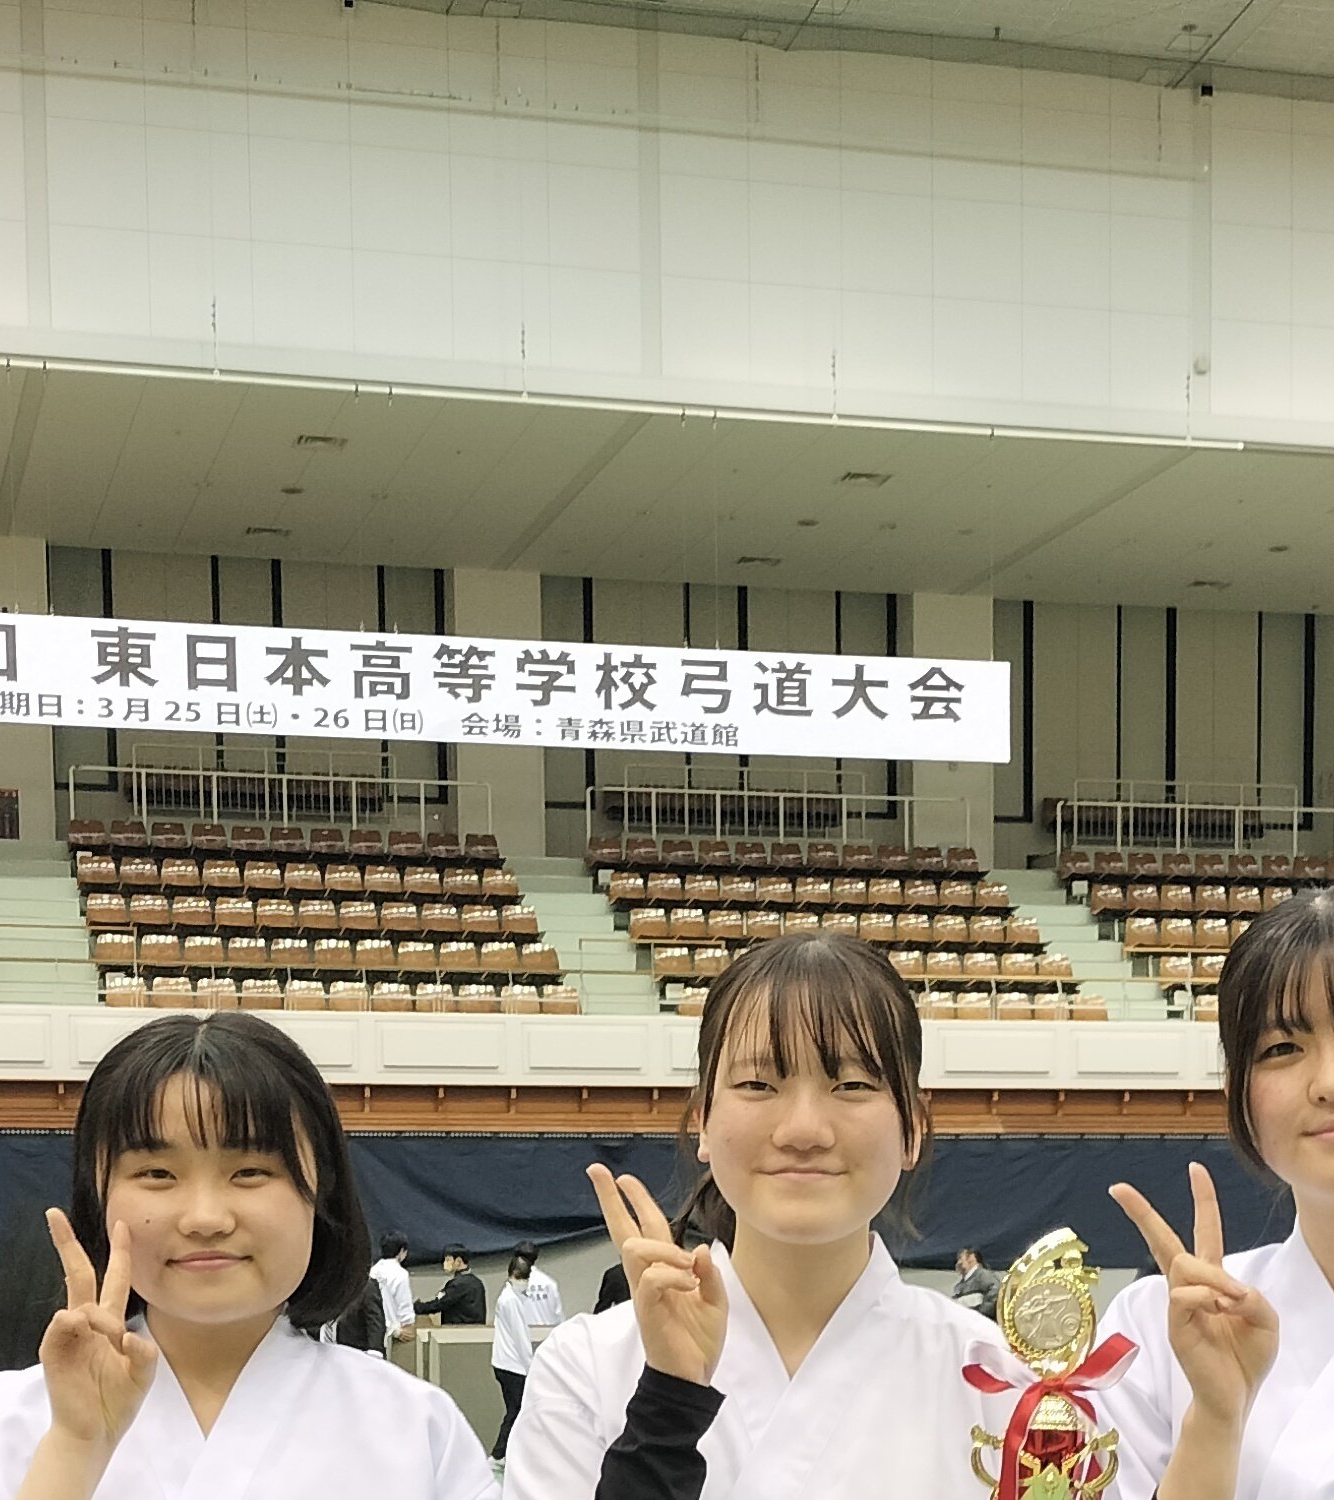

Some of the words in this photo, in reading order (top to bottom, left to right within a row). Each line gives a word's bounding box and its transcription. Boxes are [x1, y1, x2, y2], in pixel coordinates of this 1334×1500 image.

[89, 624, 967, 724] 東日本高等学校弓道大会
[460, 713, 740, 748] 会場：青森県武道館
